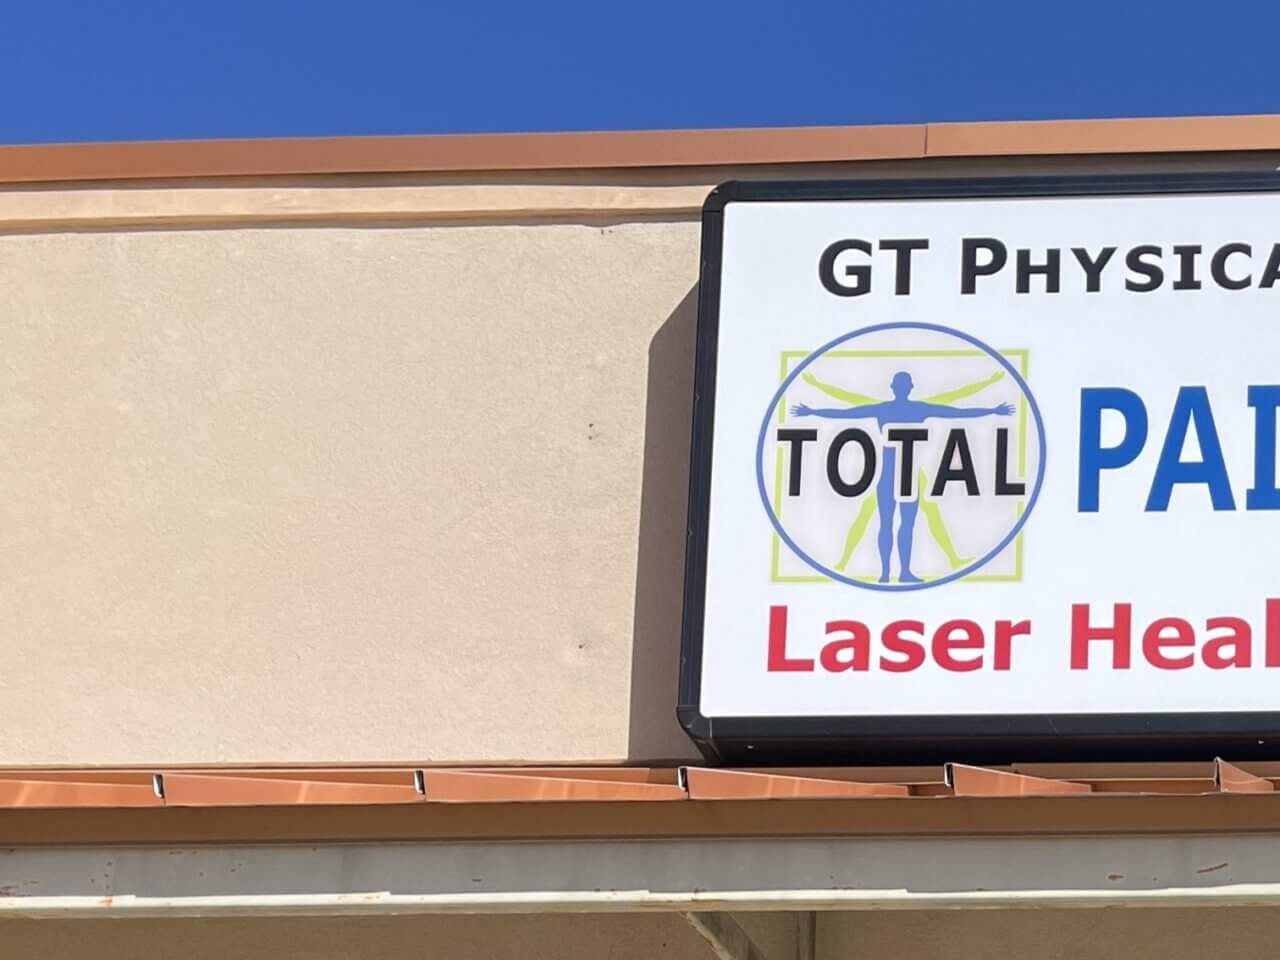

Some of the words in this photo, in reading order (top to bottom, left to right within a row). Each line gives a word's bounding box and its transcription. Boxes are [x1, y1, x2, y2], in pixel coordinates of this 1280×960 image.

[818, 238, 929, 298] GT
[777, 428, 1025, 497] TOTAL
[767, 606, 1031, 673] Laser
